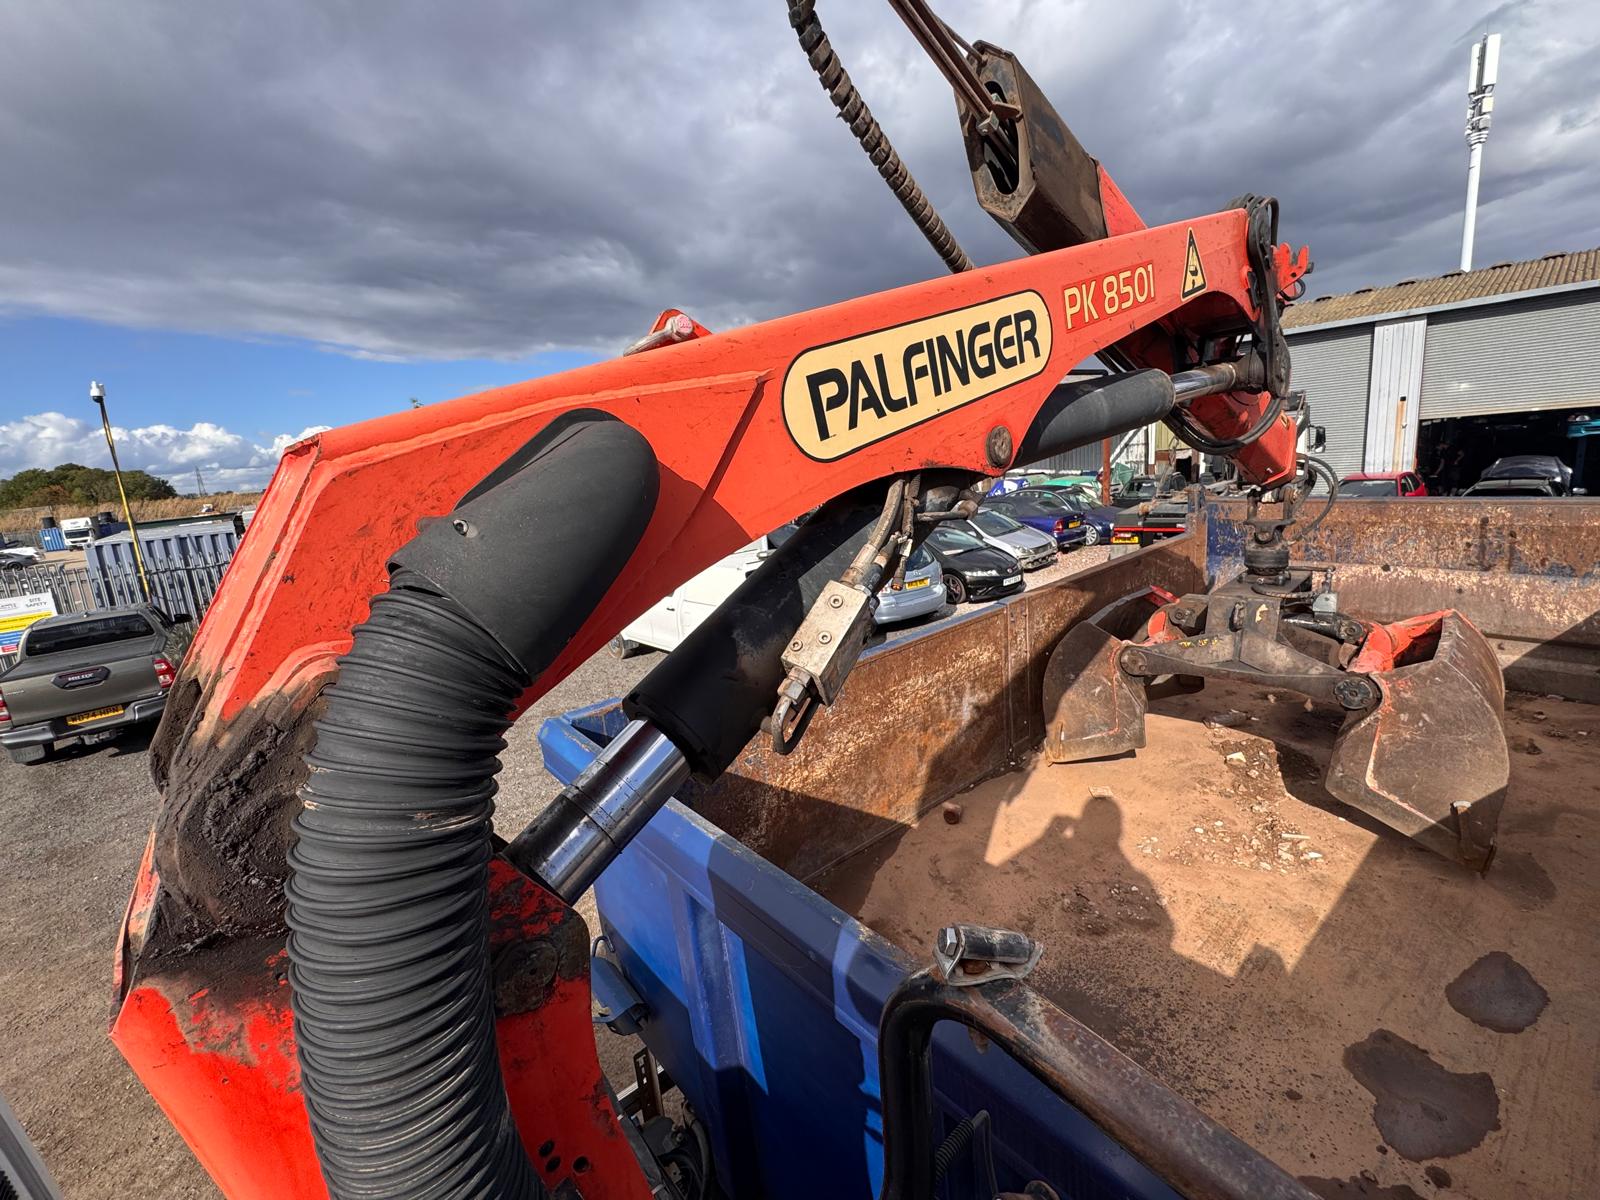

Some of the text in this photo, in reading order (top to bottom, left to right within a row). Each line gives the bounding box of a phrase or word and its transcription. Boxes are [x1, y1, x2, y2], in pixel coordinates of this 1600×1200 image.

[1064, 264, 1155, 330] PK 8501
[805, 309, 1041, 442] PALFINGER
[68, 672, 94, 681] HILUX
